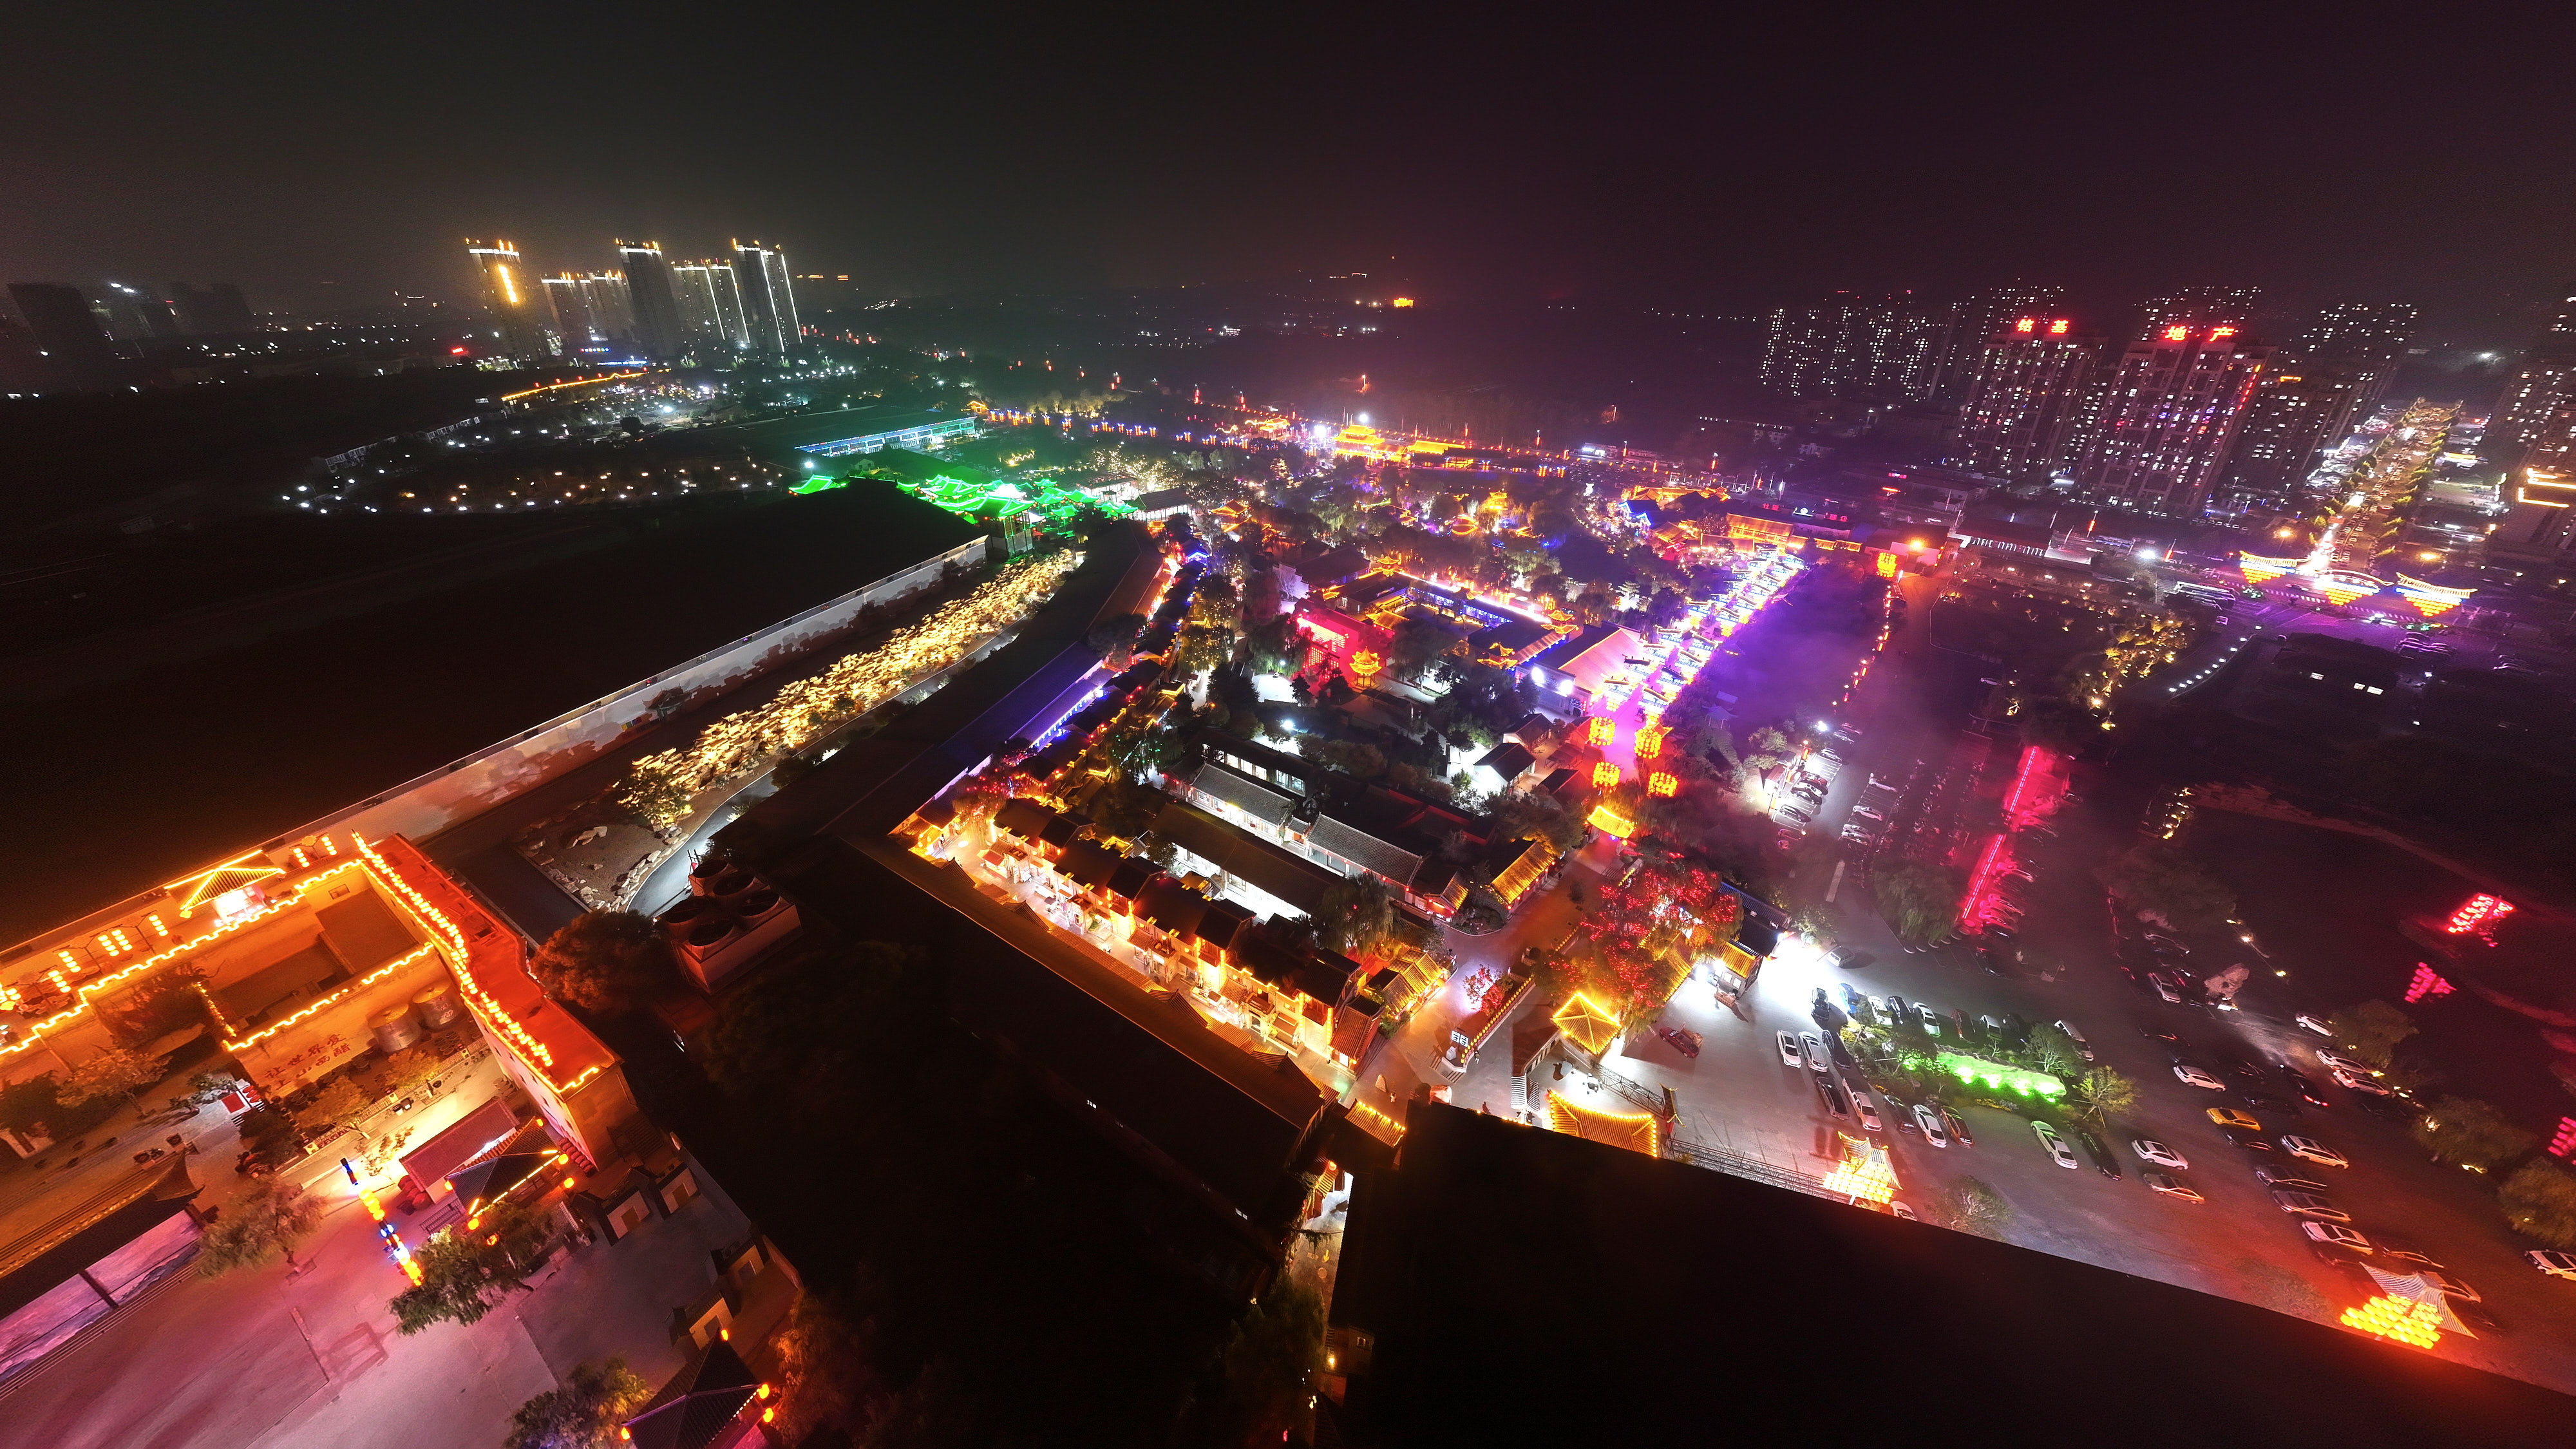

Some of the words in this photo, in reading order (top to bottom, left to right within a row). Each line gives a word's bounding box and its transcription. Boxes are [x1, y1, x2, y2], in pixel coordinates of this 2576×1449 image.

[2017, 319, 2069, 334] 铭基
[2164, 326, 2234, 343] 地产
[263, 1033, 346, 1079] 让世界爱
[277, 1043, 351, 1090] 上山西醋
